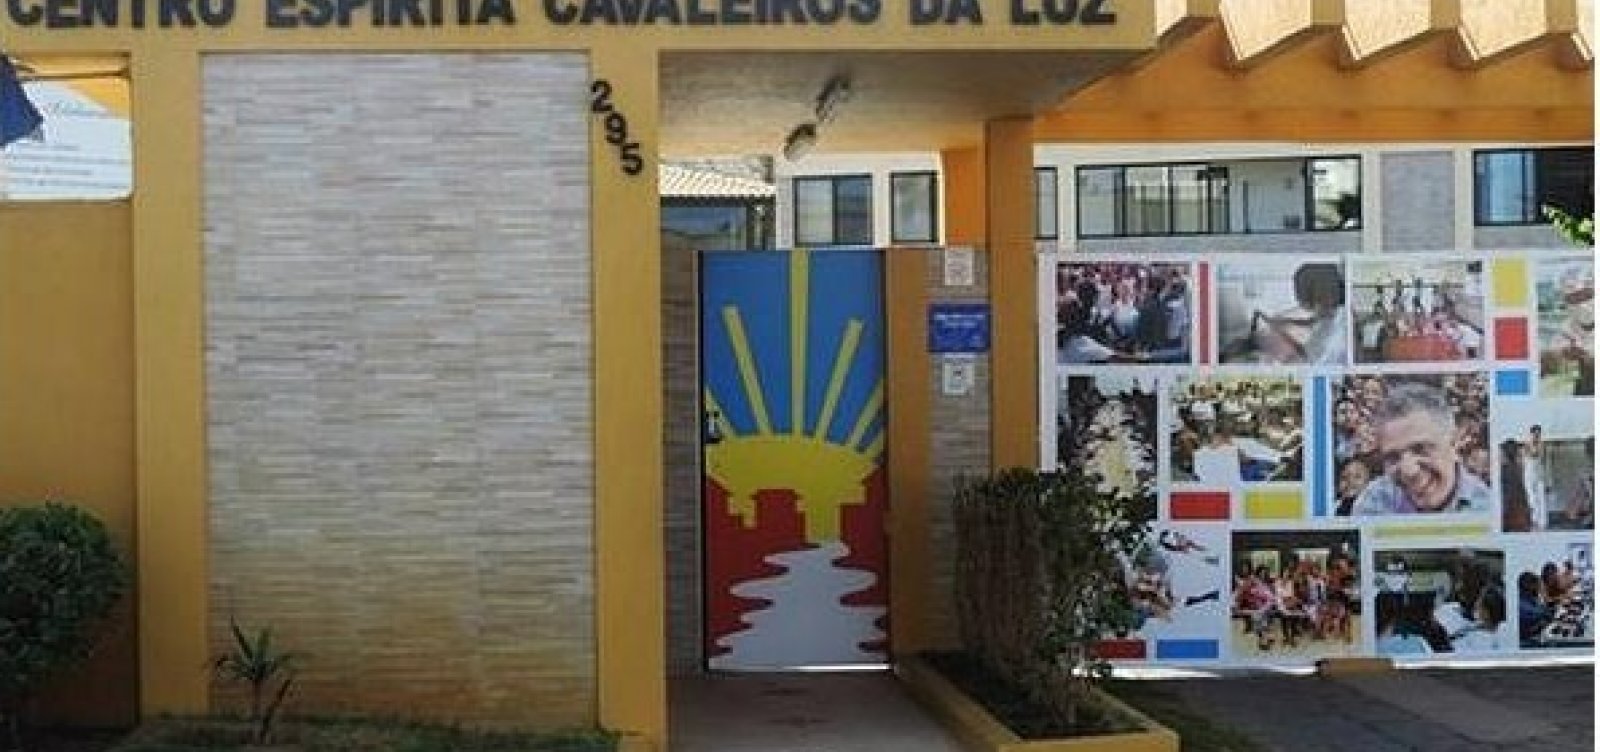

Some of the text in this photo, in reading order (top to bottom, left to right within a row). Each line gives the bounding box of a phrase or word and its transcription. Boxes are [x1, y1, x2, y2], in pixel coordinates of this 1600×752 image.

[8, 0, 236, 28] CENTRO
[545, 0, 882, 25] CAVALEIROS
[909, 0, 983, 25] DA
[1010, 0, 1118, 25] LUZ
[591, 79, 644, 175] 295
